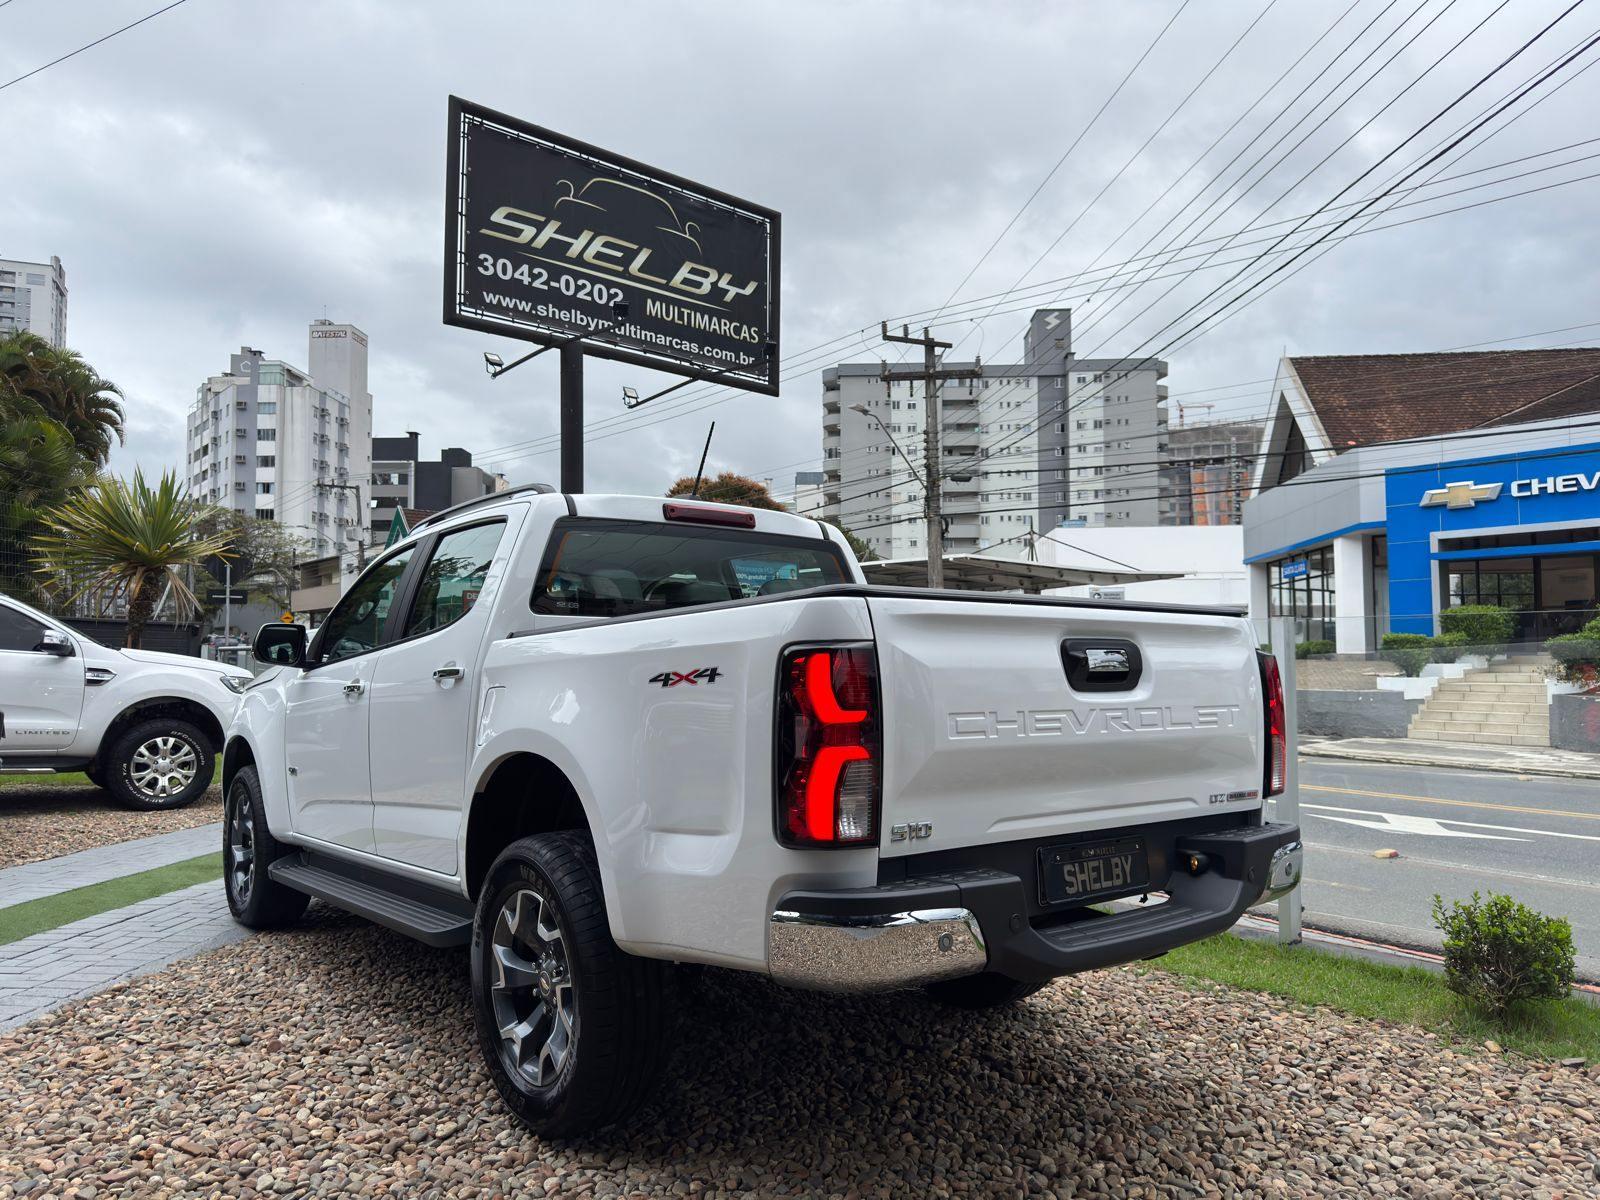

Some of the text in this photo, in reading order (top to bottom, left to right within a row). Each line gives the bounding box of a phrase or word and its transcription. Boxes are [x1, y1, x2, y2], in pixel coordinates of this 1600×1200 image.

[478, 206, 759, 302] SHELBY
[476, 253, 624, 307] 3042-0202
[646, 298, 760, 345] MULTIMARCAS
[948, 704, 1241, 740] CHEVROLET
[890, 821, 933, 842] S10
[1063, 854, 1132, 895] SHELBY
